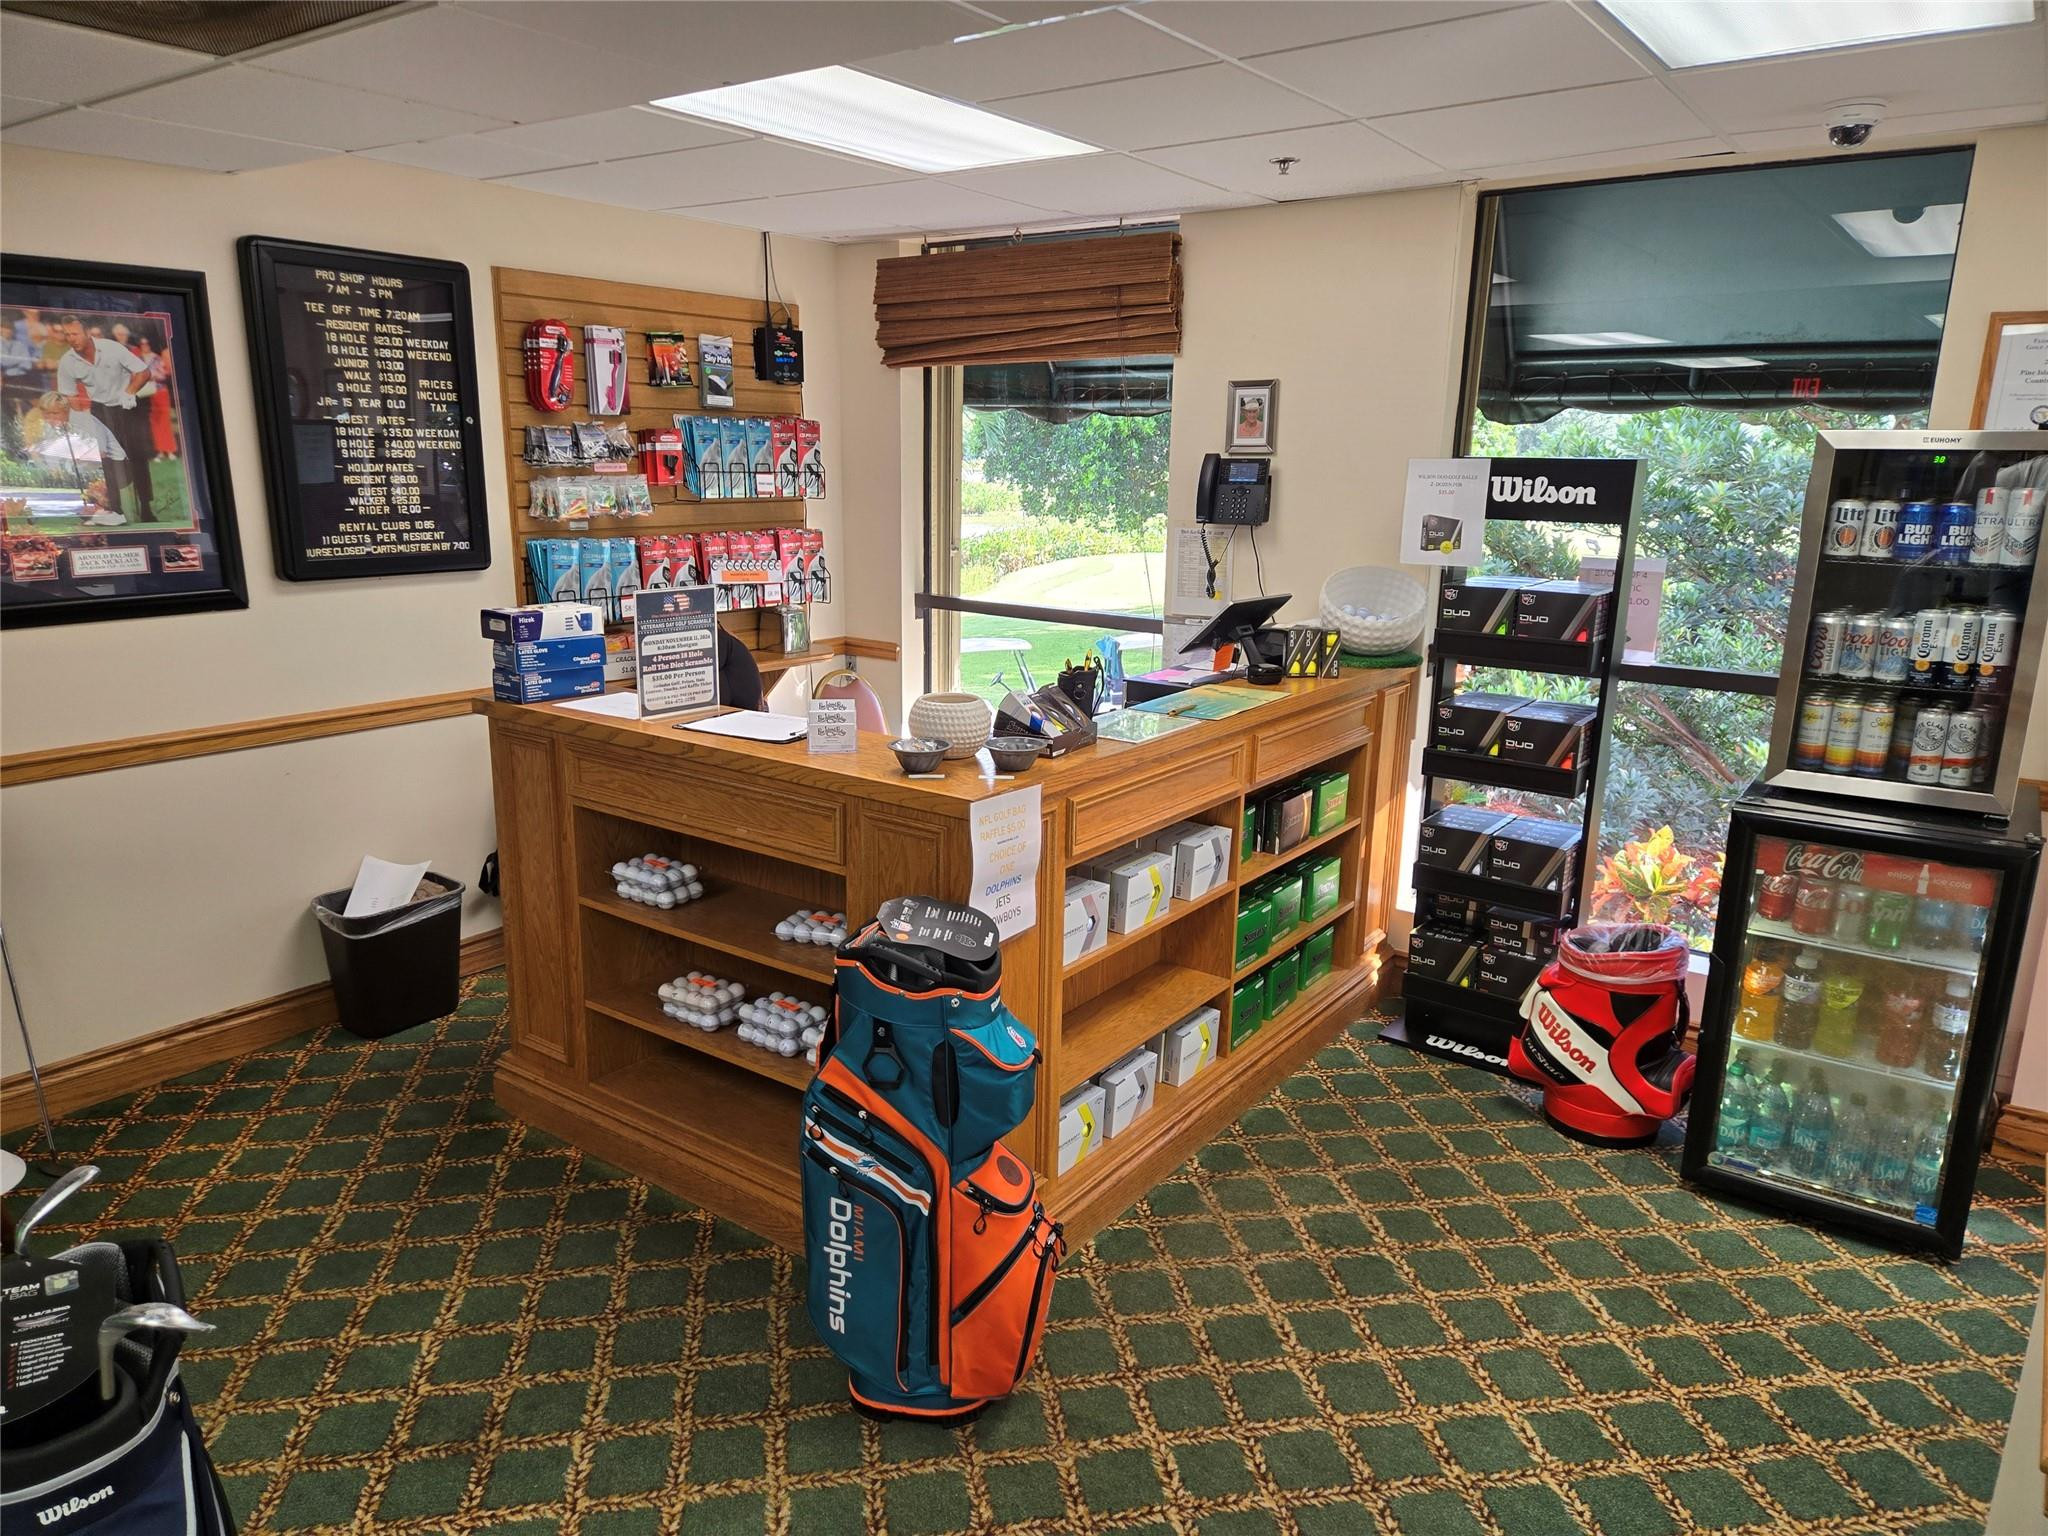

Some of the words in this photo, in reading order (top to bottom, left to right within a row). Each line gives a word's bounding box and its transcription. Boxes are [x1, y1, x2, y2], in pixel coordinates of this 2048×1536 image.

[315, 270, 335, 281] PRO
[340, 272, 365, 283] SHOP
[372, 276, 403, 288] HOURS
[328, 284, 333, 294] 7
[336, 286, 349, 295] AM
[304, 302, 325, 313] TEE
[332, 304, 351, 316] OFF
[358, 307, 382, 319] TIME
[340, 332, 367, 344] HOLE
[406, 338, 449, 350] WEEKDAY
[341, 346, 369, 357] HOLE
[406, 350, 452, 362] WEEKEND
[704, 354, 717, 364] Sky
[717, 354, 732, 364] Mark
[334, 358, 369, 369] JUNIOR
[344, 371, 372, 382] WALK
[346, 383, 372, 394] HOLE
[419, 380, 453, 390] PRICES
[417, 391, 458, 401] INCLUDE
[358, 400, 381, 408] YEAR
[387, 400, 406, 409] OLD
[430, 404, 447, 412] TAX
[376, 416, 405, 425] RATES
[348, 428, 375, 437] HOLE
[416, 428, 460, 438] WEEKDAY
[348, 440, 375, 449] HOLE
[417, 440, 462, 450] WEEKEND
[350, 450, 376, 458] HOLE
[348, 464, 383, 472] HOLIDAY
[386, 464, 415, 472] RATES
[344, 476, 386, 484] RESIDENT
[358, 487, 388, 496] GUEST
[1490, 476, 1597, 505] Wilson
[349, 496, 386, 506] WALKER
[358, 506, 390, 515] RIDER
[1836, 507, 1866, 522] Lite
[339, 523, 378, 532] RENTAL
[382, 522, 411, 530] CLUBS
[1904, 524, 1933, 536] BUD
[376, 534, 397, 542] PER
[403, 532, 445, 541] RESIDENT
[1898, 534, 1934, 545] LIGH
[1941, 536, 1974, 546] LIGH
[1443, 608, 1471, 617] DUO
[640, 622, 665, 630] VETERANS
[688, 618, 712, 626] SCRAMBLE
[1520, 614, 1549, 623] DUO
[1918, 620, 1933, 658] Corona
[1956, 622, 1973, 660] Corona
[1982, 624, 1997, 662] Corona
[1810, 624, 1828, 670] Coors
[1826, 640, 1835, 661] LIGHT
[1846, 644, 1870, 653] GHT
[1880, 647, 1910, 657] LIGH
[658, 654, 680, 662] Person
[657, 662, 670, 670] The
[685, 658, 713, 668] Scramble
[684, 670, 705, 678] Person
[1438, 727, 1465, 736] DUO
[1506, 740, 1534, 750] DUO
[978, 814, 992, 826] NFL
[994, 810, 1012, 822] GOLF
[1013, 804, 1026, 817] BAG
[980, 827, 1006, 841] RAFFLE
[989, 846, 1017, 863] CHOICE
[1018, 842, 1027, 853] OF
[1422, 846, 1447, 855] DUO
[1000, 862, 1015, 874] ONE
[1492, 858, 1521, 870] DUO
[1783, 844, 1864, 882] Coca-Cola
[1888, 870, 1913, 881] enjoy
[986, 874, 1022, 896] DOLPHINS
[995, 894, 1011, 909] JETS
[993, 906, 1021, 925] OWBOYS
[1437, 909, 1462, 919] DUO
[1490, 920, 1518, 931] DUO
[1494, 936, 1522, 947] DUO
[1411, 954, 1436, 966] DUO
[1481, 971, 1508, 984] DUO
[1538, 1002, 1596, 1074] Wilson
[854, 1204, 865, 1262] MIAMI
[824, 1196, 852, 1334] Dolphins
[2, 1283, 40, 1295] TEAM
[10, 1290, 38, 1301] BAG
[36, 1485, 115, 1525] Wilson
